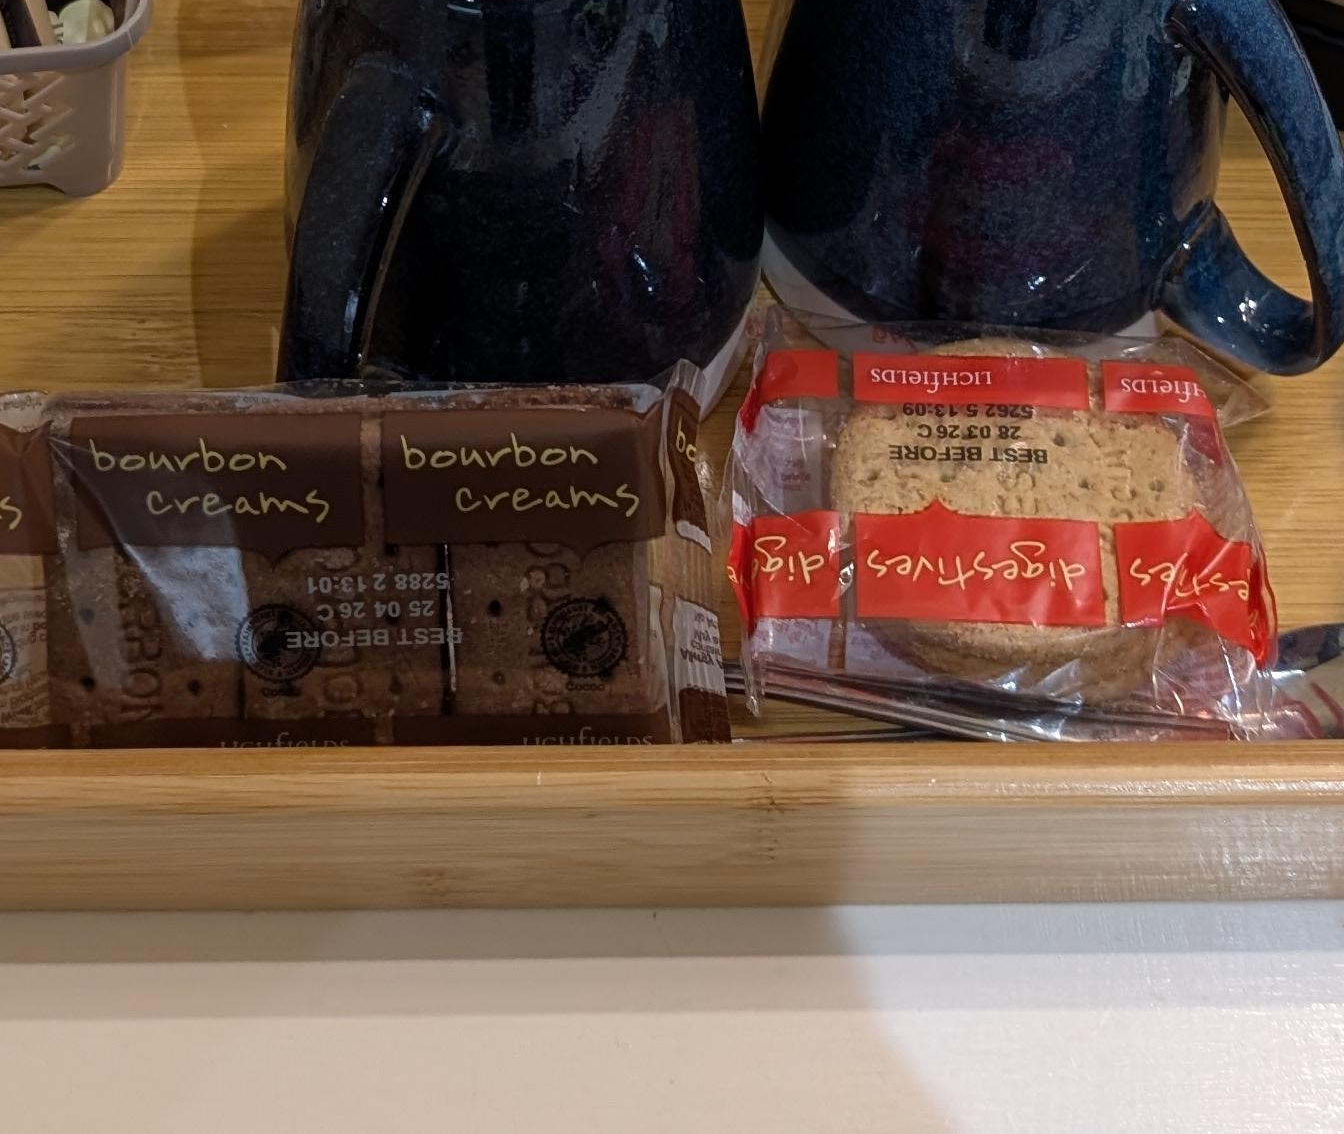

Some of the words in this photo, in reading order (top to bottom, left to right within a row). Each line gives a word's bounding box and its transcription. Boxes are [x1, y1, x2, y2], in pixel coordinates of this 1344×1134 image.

[903, 403, 958, 416] 13:09
[966, 404, 979, 416] 5
[985, 404, 1034, 418] 5262
[917, 424, 932, 438] C
[936, 424, 960, 438] 26
[967, 425, 991, 439] 03
[998, 426, 1021, 439] 28
[89, 438, 287, 472] bourbon
[400, 432, 598, 469] bourbon
[888, 445, 982, 461] BEFORE
[989, 447, 1048, 464] BEST
[146, 490, 329, 523] creams
[456, 484, 640, 517] creams
[867, 540, 1087, 591] digestives
[307, 575, 368, 595] 13:01
[371, 573, 386, 591] 2
[394, 572, 451, 590] 5288
[316, 604, 334, 621] C
[339, 602, 365, 619] 26
[373, 601, 401, 618] 04
[408, 600, 436, 618] 25
[285, 628, 390, 649] BEFORE
[396, 627, 464, 646] BEST
